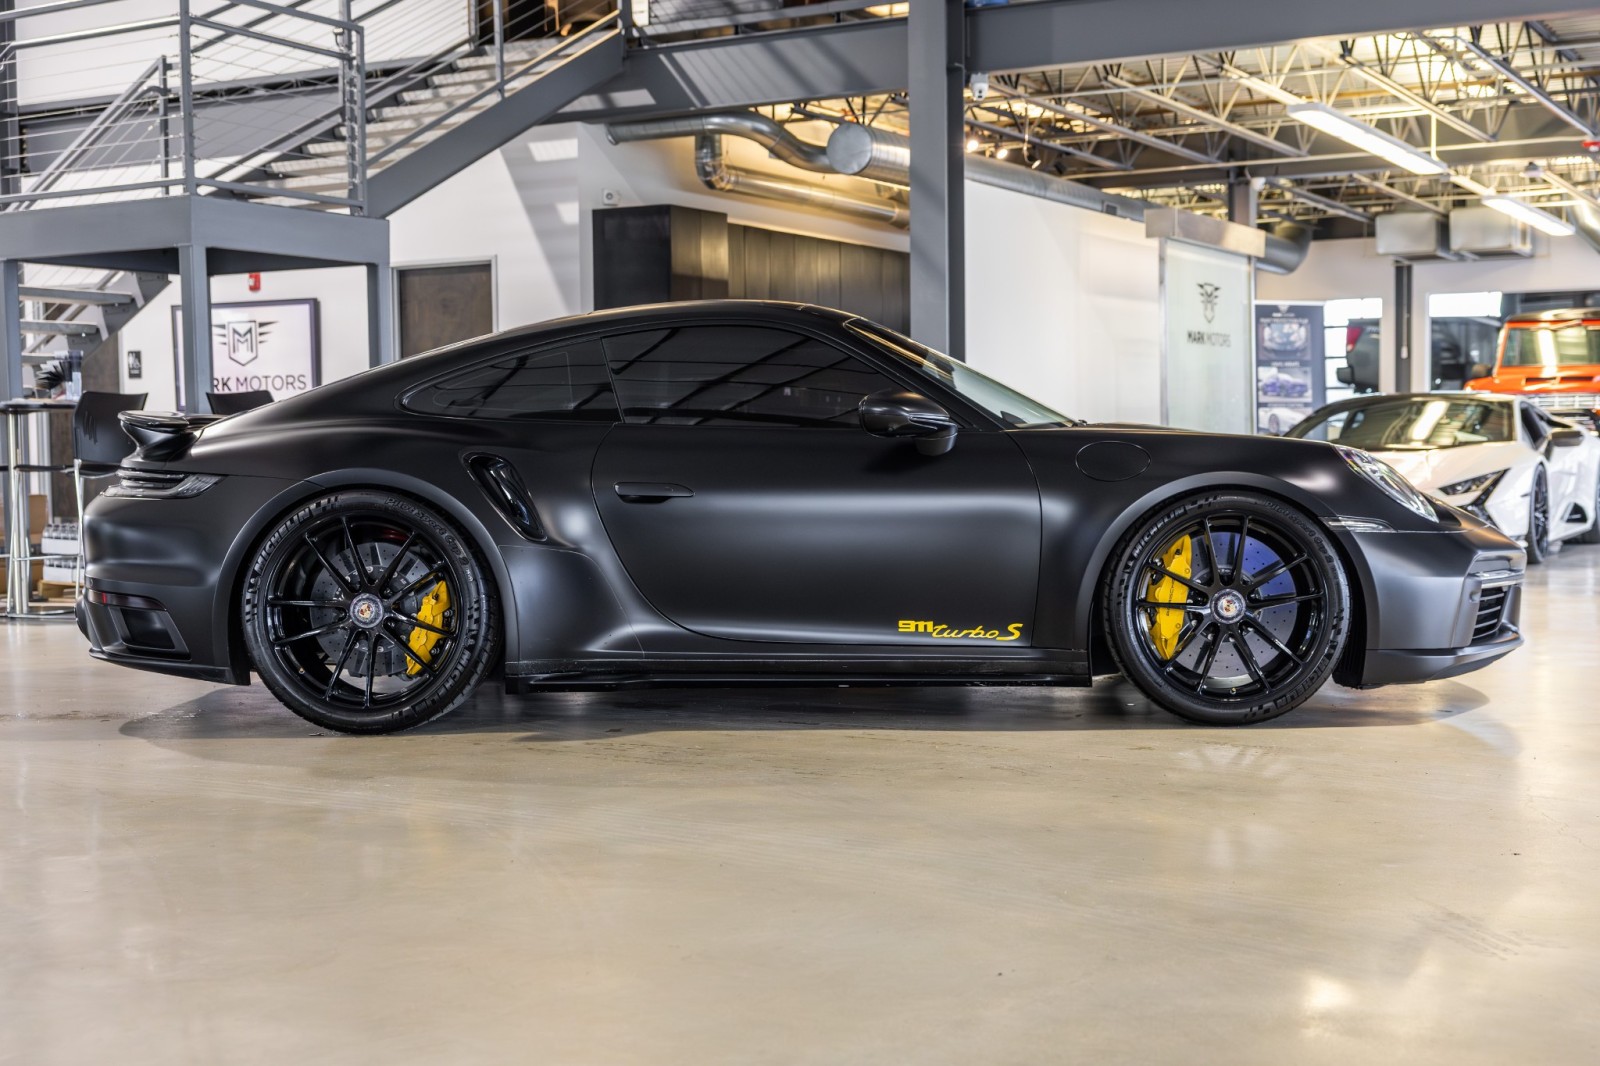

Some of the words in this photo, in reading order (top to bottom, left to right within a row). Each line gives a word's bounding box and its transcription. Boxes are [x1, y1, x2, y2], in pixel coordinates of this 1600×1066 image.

[213, 377, 231, 392] RK
[236, 374, 307, 392] MOTORS
[254, 507, 312, 576] MICHELIN
[1132, 506, 1186, 559] MICHELIN
[898, 620, 933, 633] 911
[932, 624, 1000, 639] turbo
[996, 623, 1024, 641] S
